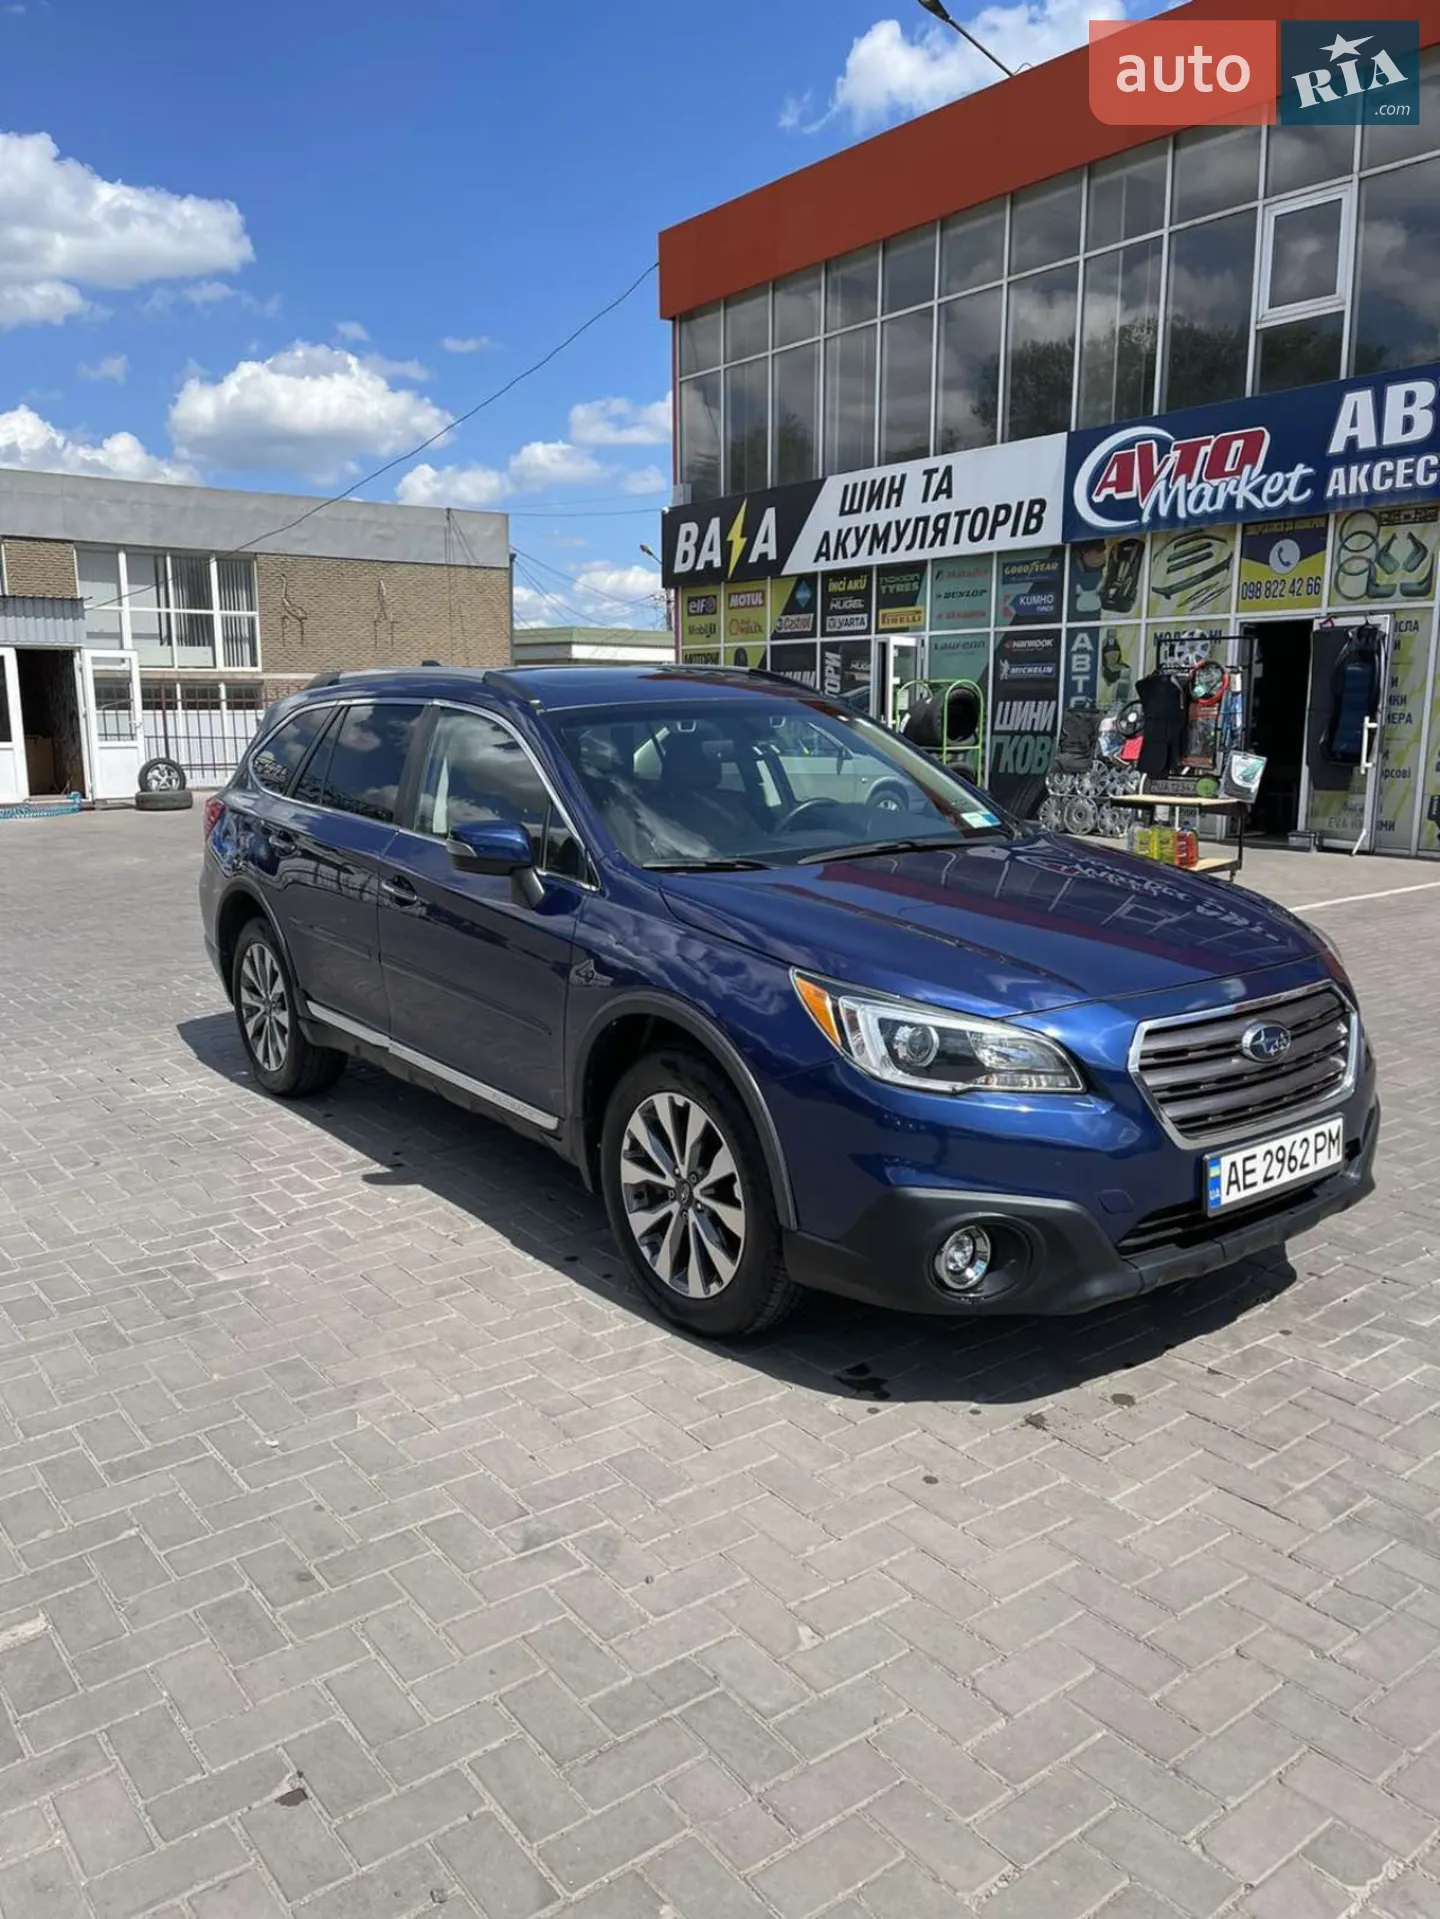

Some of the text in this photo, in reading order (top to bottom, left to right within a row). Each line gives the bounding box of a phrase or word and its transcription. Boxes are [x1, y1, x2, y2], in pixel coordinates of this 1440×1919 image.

[1092, 427, 1271, 509] AVTO
[838, 465, 954, 517] ШИН ТА
[1141, 463, 1317, 523] Market
[813, 497, 1048, 564] АКУМУЛЯТОРІВ
[1004, 561, 1059, 576] GOODYEAR
[1241, 576, 1321, 600] 098 822 42 66
[688, 598, 706, 613] elf
[729, 593, 763, 607] MOTUL
[1019, 594, 1055, 606] KUMHO
[839, 617, 867, 628] VARTA
[880, 610, 922, 626] PIRELLI
[1010, 665, 1054, 675] MICHELIN
[993, 700, 1057, 731] ШИНИ
[1226, 1124, 1341, 1196] AE 2962 PM
